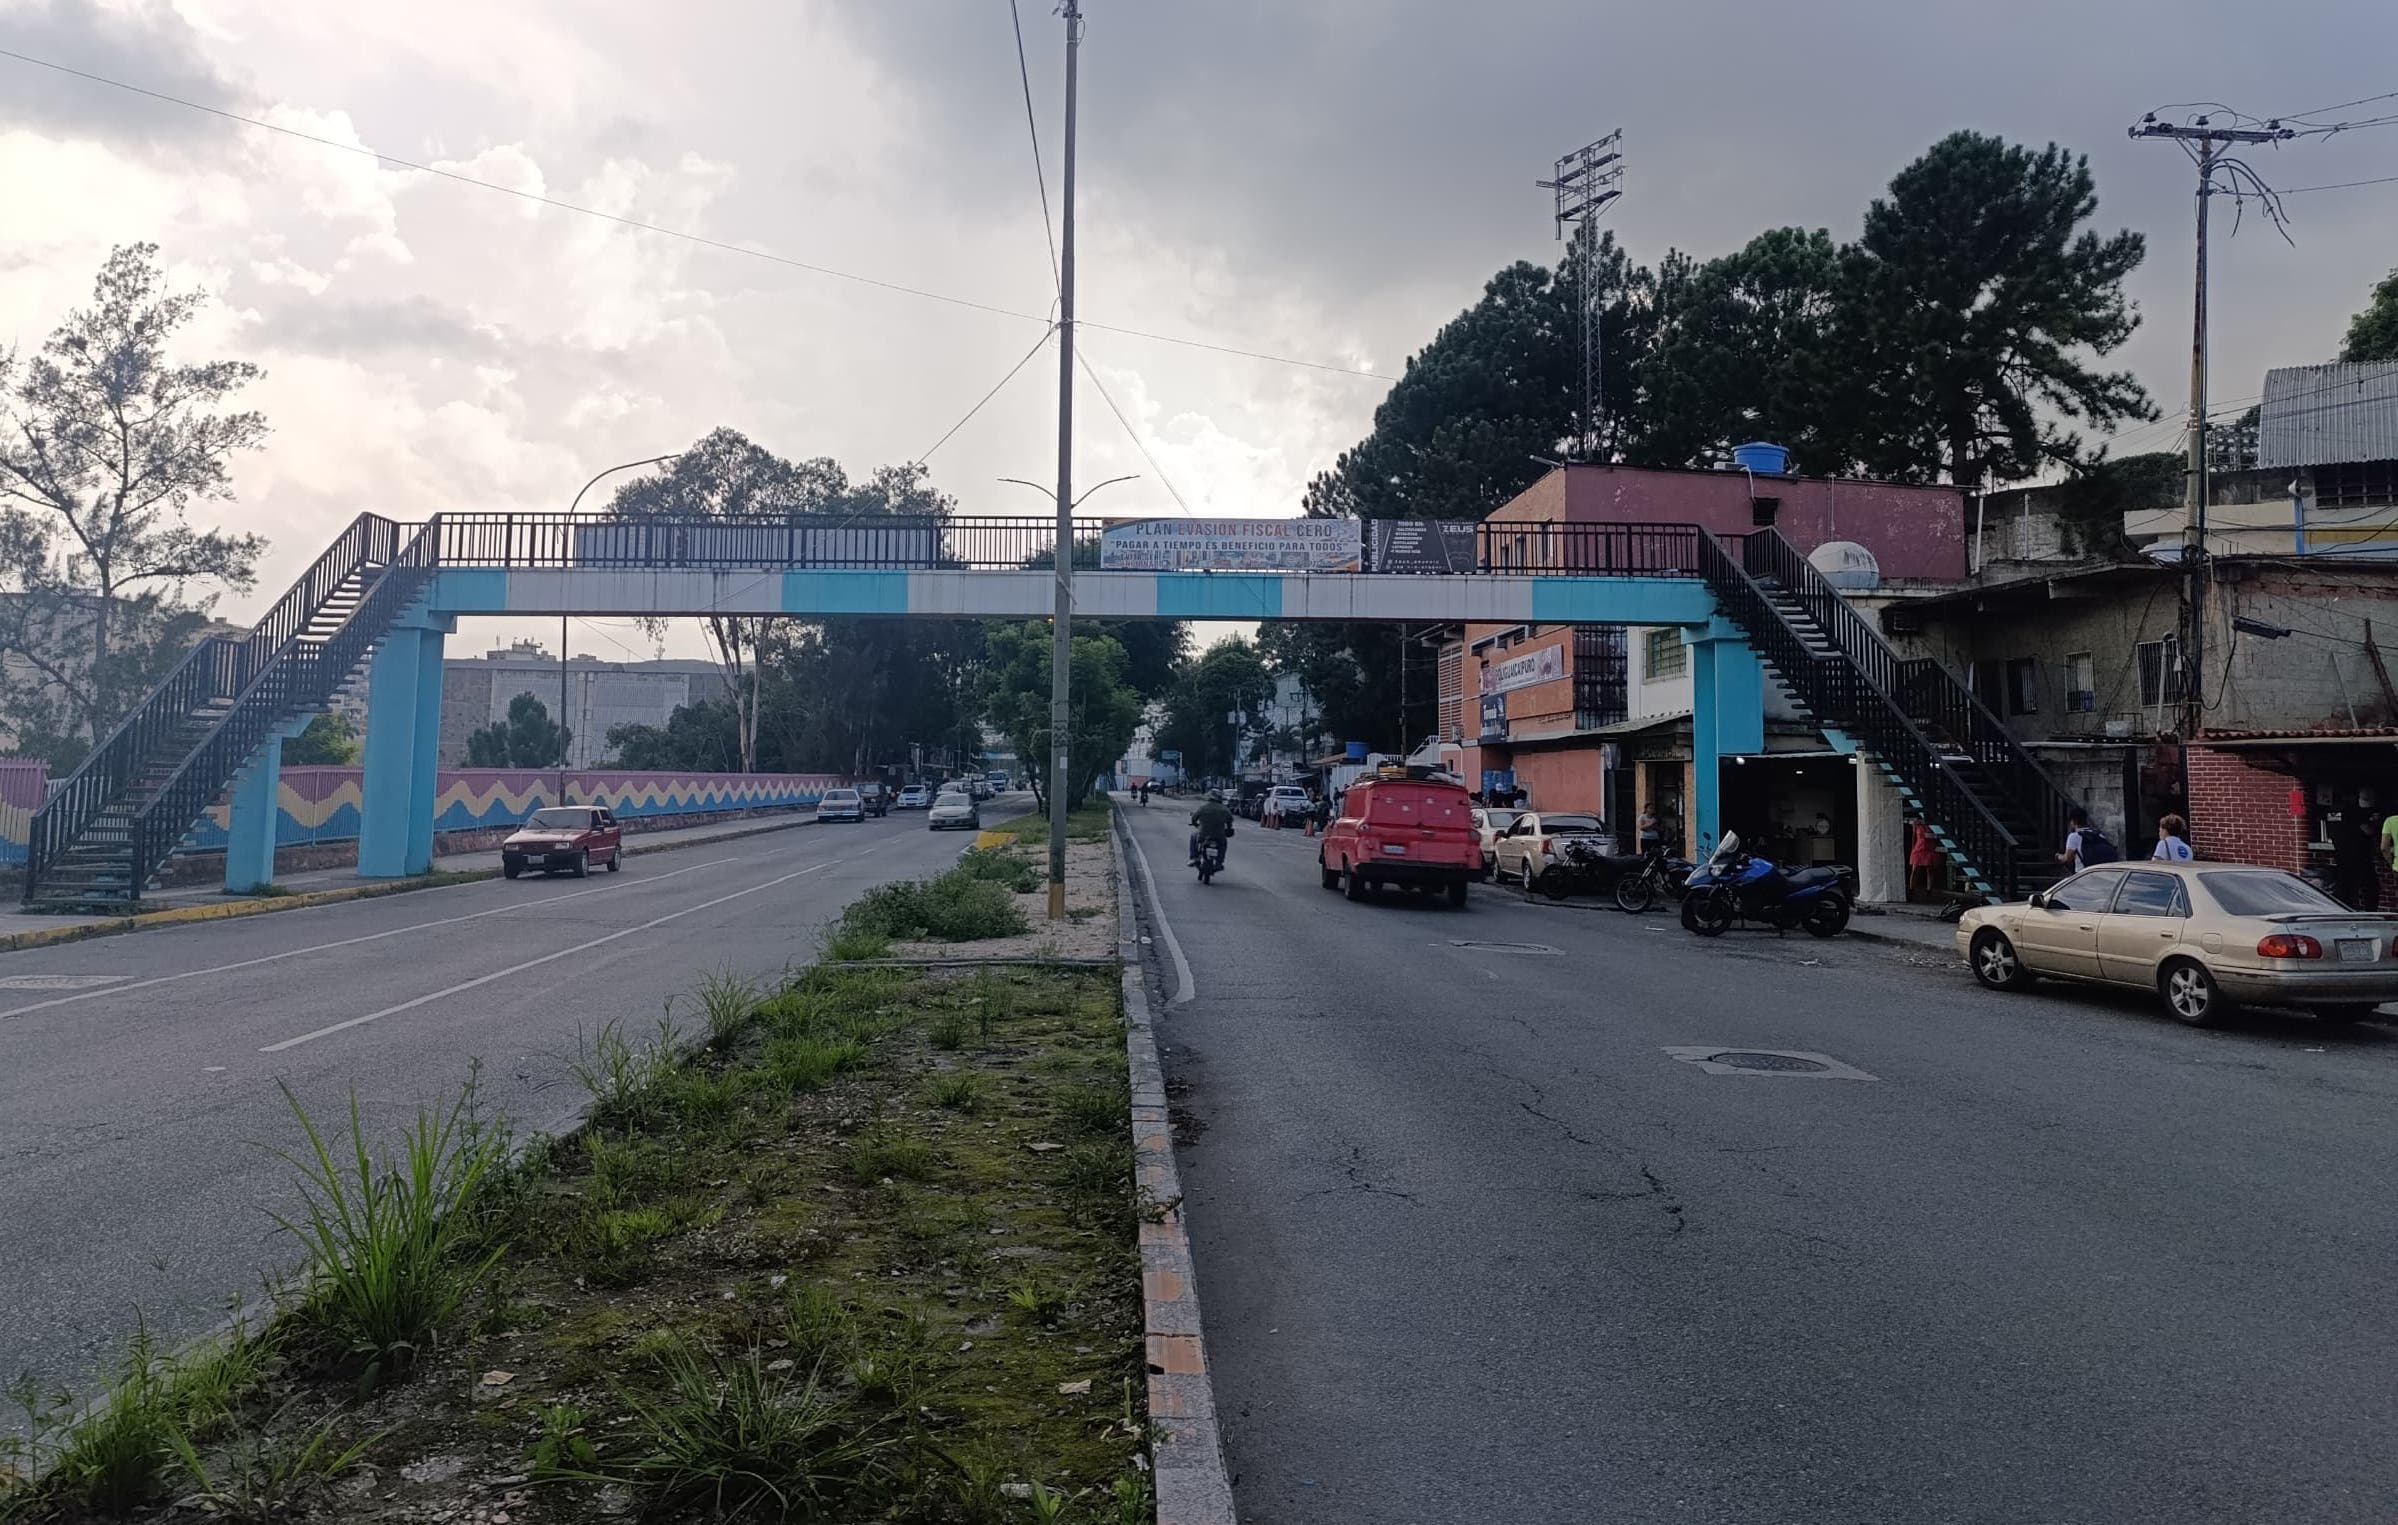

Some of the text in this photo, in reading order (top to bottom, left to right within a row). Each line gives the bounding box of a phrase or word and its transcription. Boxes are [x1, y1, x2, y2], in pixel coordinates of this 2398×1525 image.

[1136, 523, 1332, 537] PLAN EVASION FISCAL CERO
[1442, 525, 1474, 533] ZEUS
[1153, 540, 1159, 549] A
[1164, 541, 1202, 550] TIEMPO
[1206, 541, 1218, 550] ES
[1221, 541, 1275, 551] BENEFICIO
[1279, 542, 1305, 551] PARA
[1371, 519, 1379, 572] PUBLICIDAD
